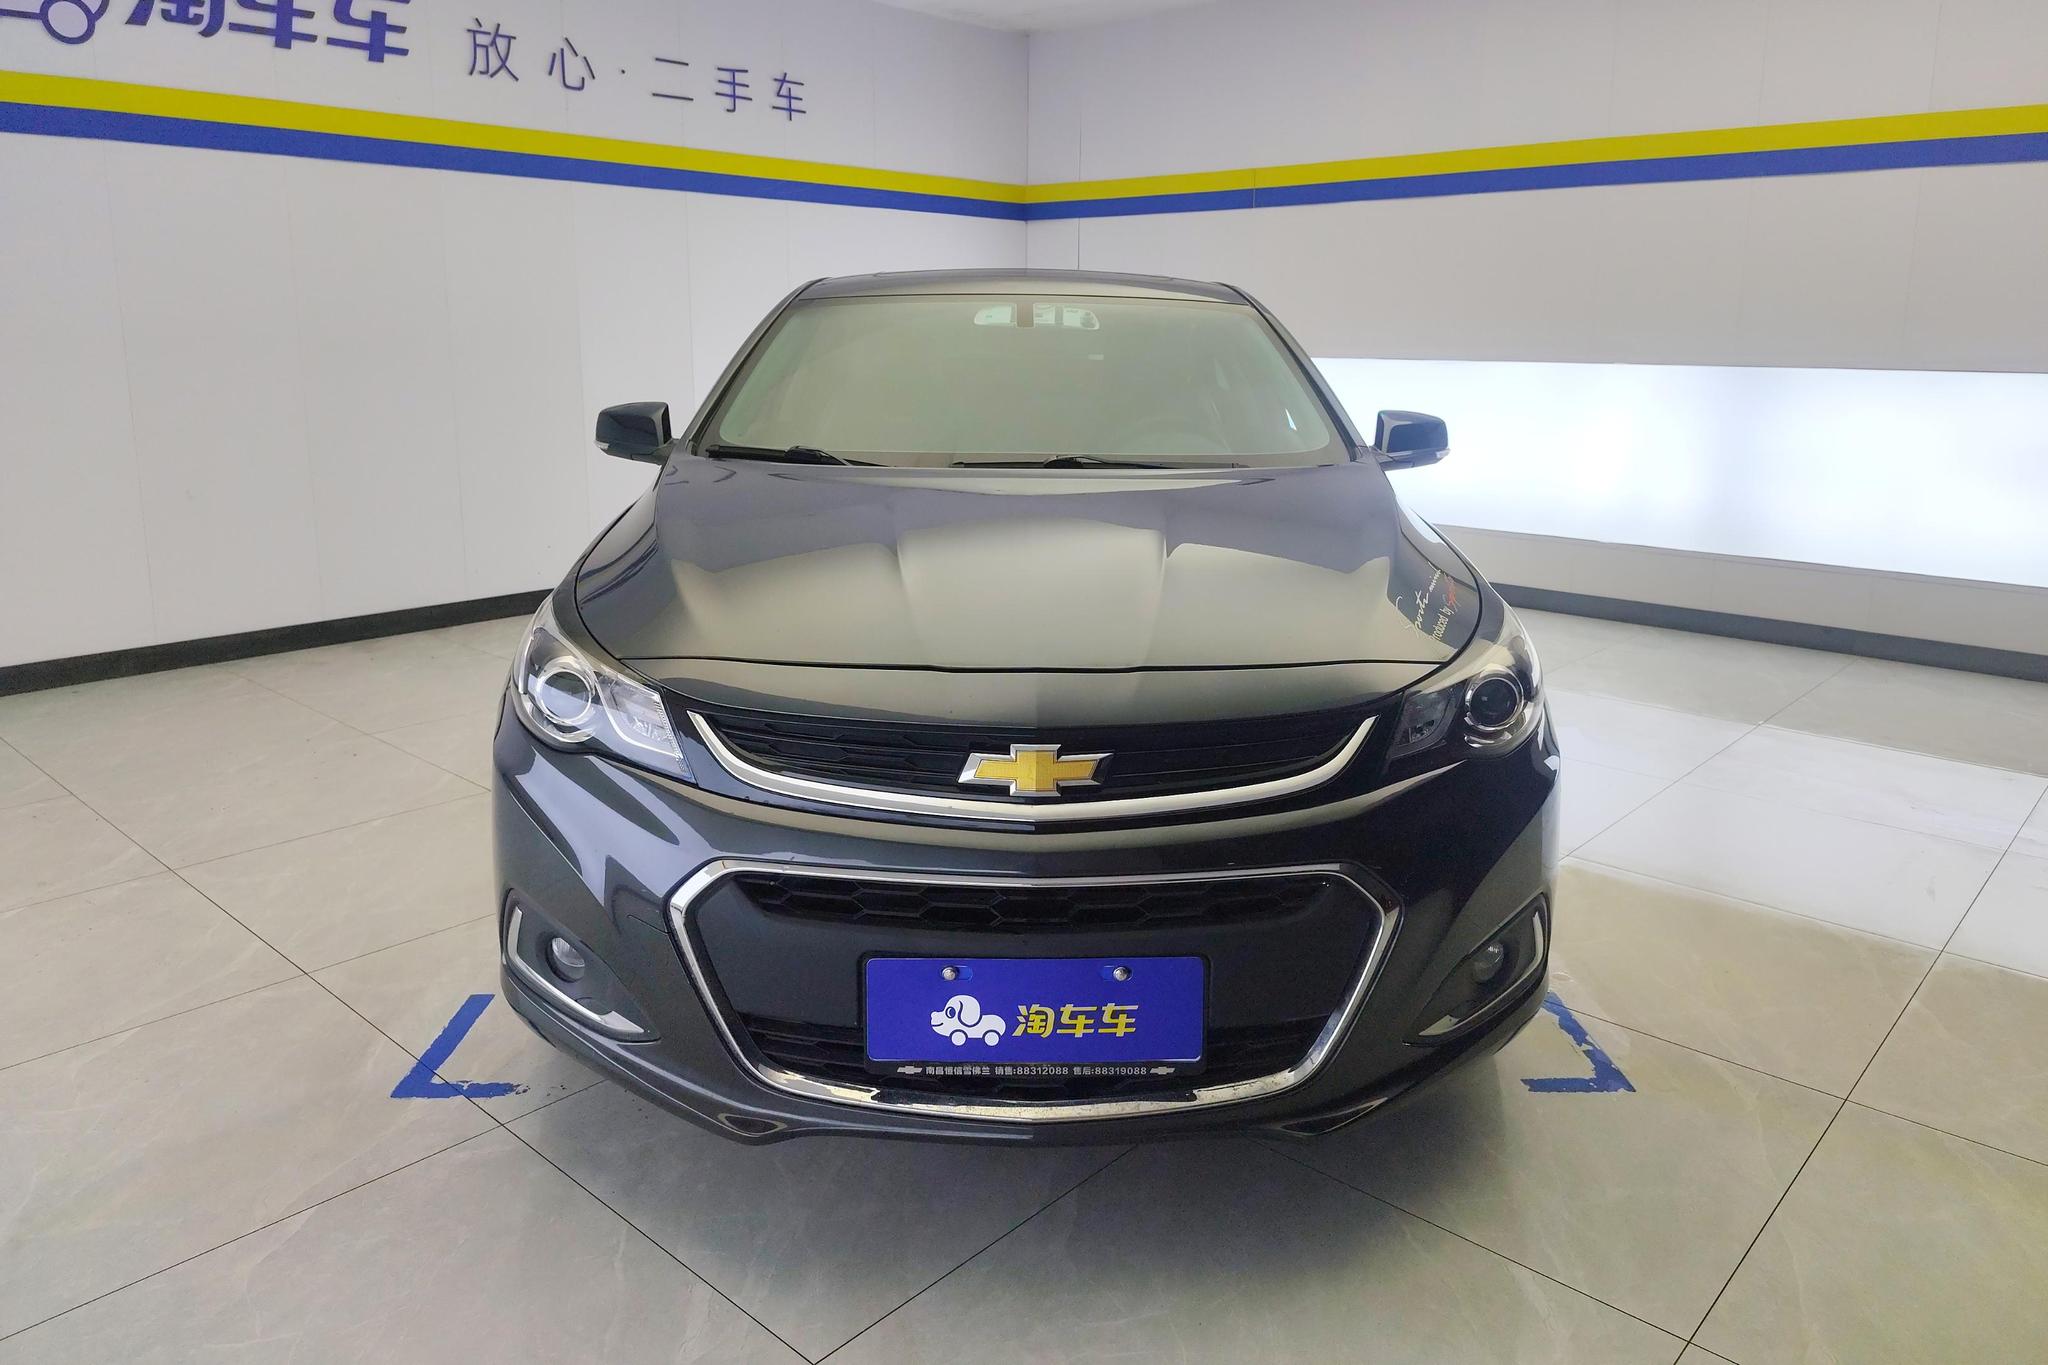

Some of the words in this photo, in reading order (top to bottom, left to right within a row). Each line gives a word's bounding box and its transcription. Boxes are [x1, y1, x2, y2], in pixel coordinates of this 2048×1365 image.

[1012, 1003, 1139, 1038] 淘车车
[995, 1066, 1069, 1076] 销售:88312088
[1073, 1066, 1147, 1076] 售后:88319088
